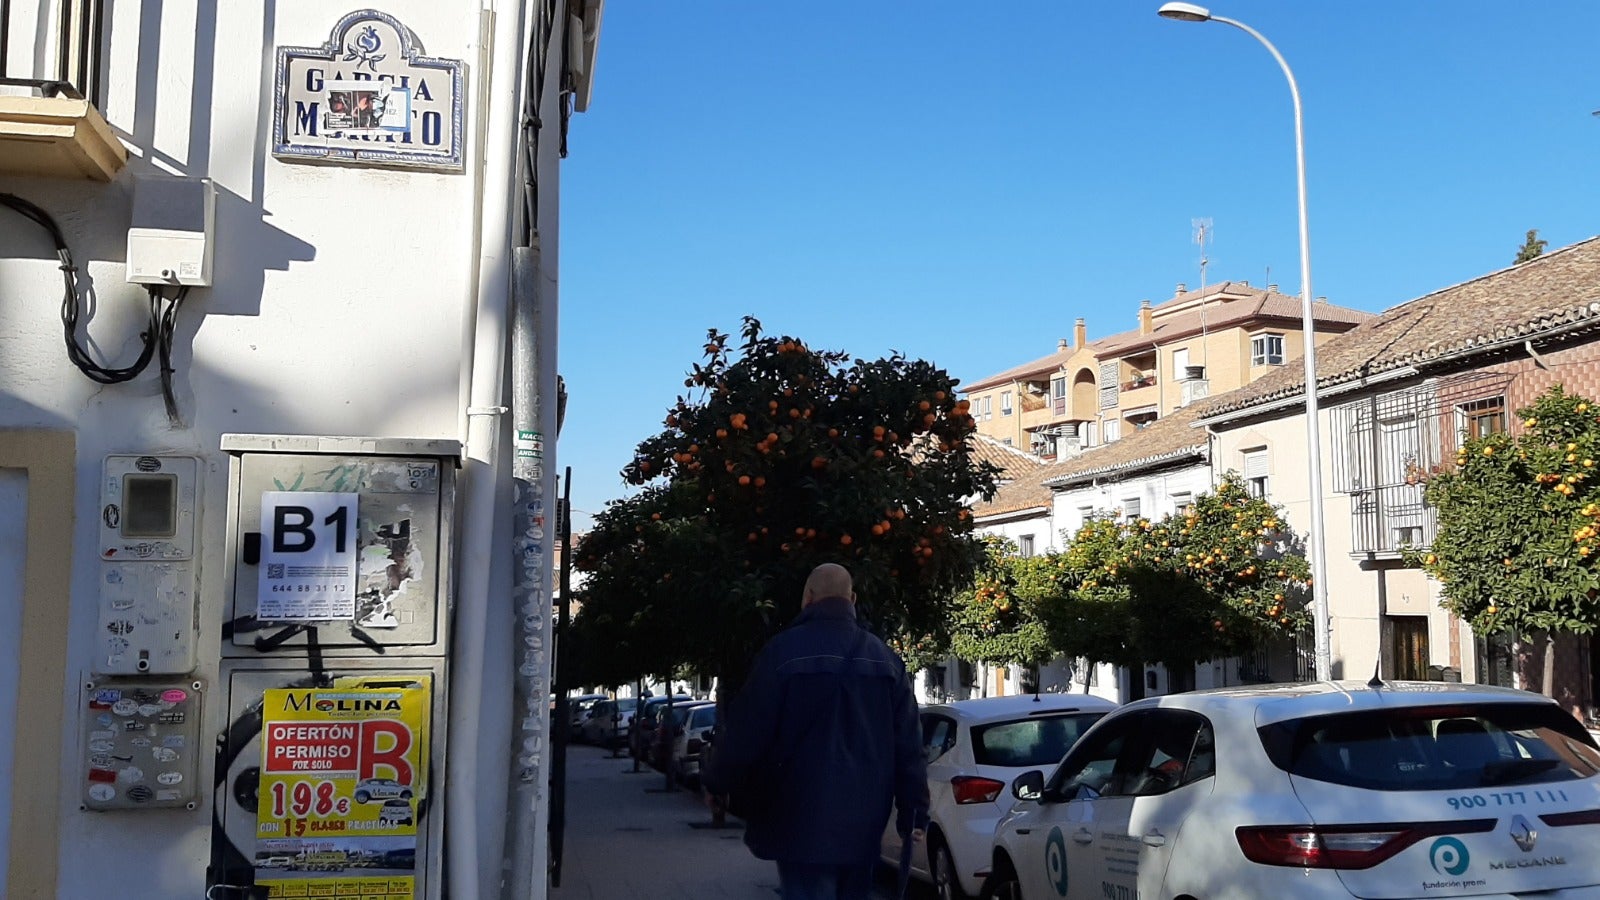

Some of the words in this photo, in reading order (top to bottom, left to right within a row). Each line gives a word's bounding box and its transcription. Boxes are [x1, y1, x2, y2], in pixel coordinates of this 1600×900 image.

[272, 505, 348, 554] B1
[272, 584, 293, 593] 644
[297, 584, 310, 593] 88
[316, 584, 327, 593] 31
[334, 584, 346, 593] 13
[283, 692, 402, 712] MOLINA
[273, 724, 354, 741] OFERTÓN
[274, 744, 352, 759] PERMISO
[292, 760, 310, 770] POR
[311, 759, 333, 769] SOLO
[1446, 794, 1487, 810] 900
[1490, 791, 1526, 806] 777
[1533, 789, 1569, 803] 111
[259, 822, 280, 833] CON
[283, 818, 308, 838] 15
[310, 820, 346, 832] CLASES
[1489, 855, 1567, 870] MEGANE
